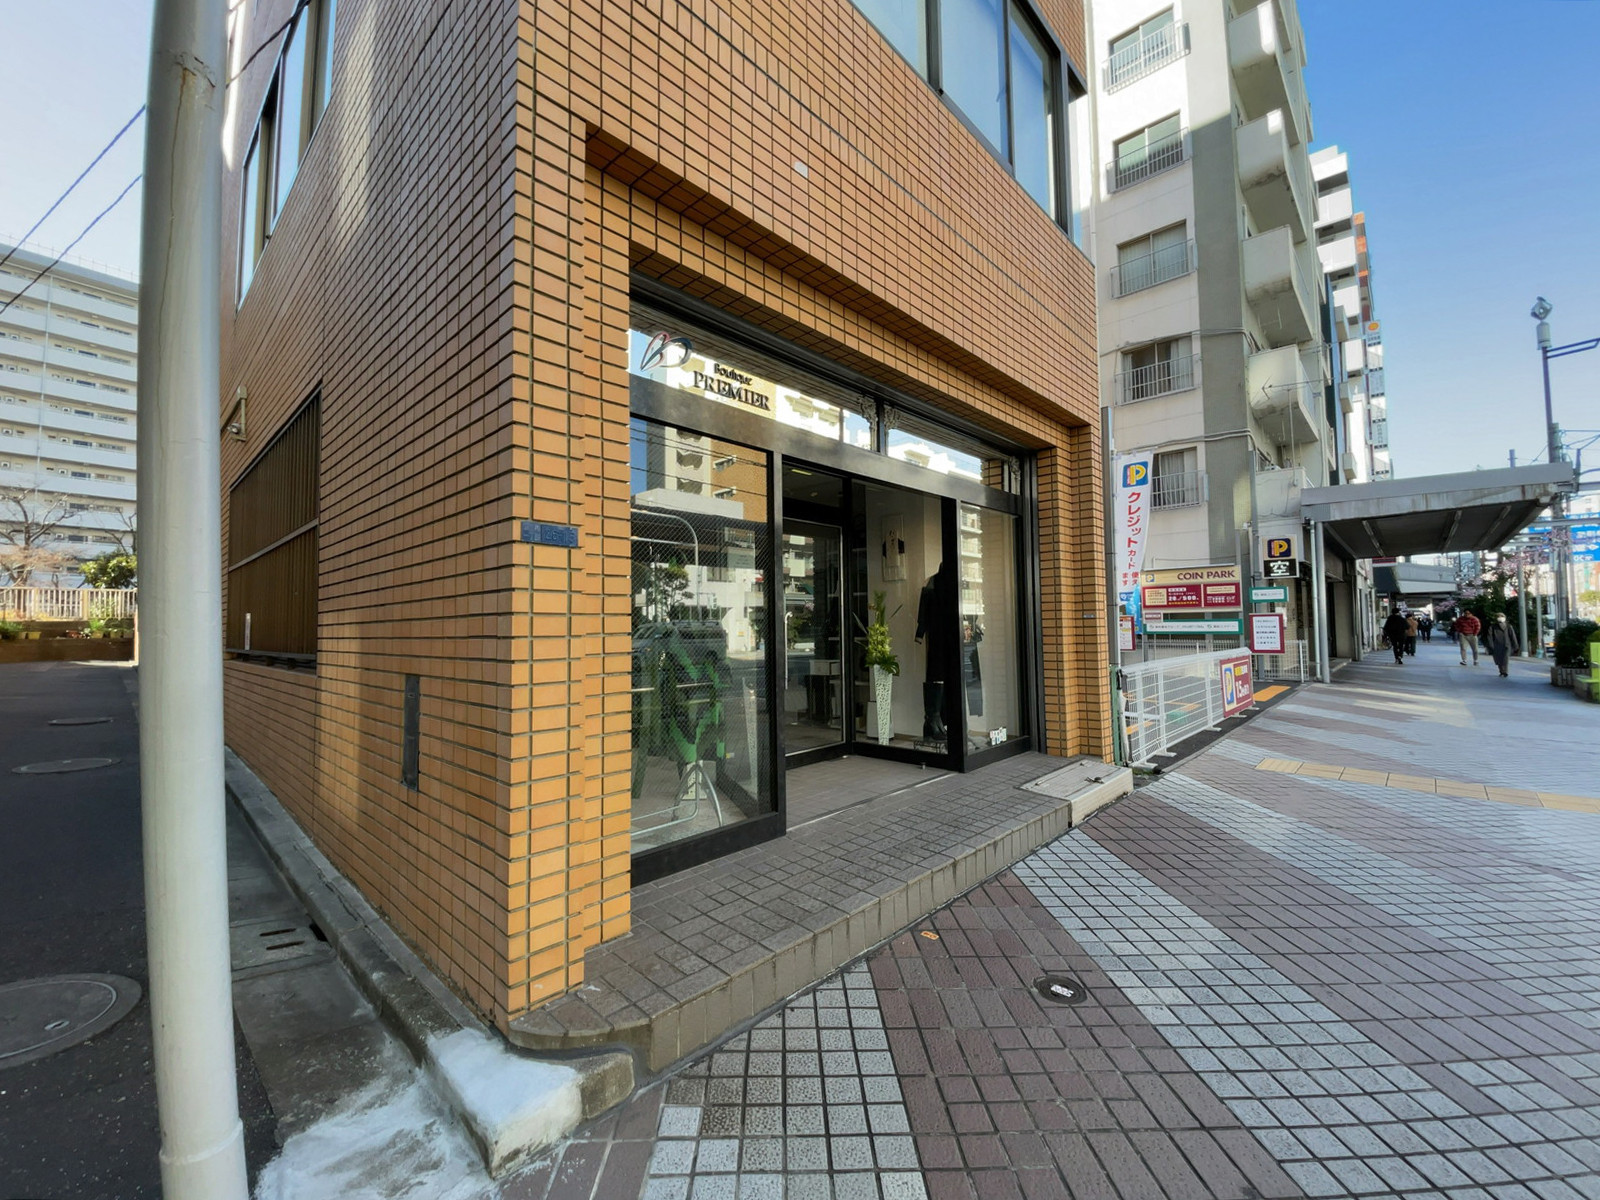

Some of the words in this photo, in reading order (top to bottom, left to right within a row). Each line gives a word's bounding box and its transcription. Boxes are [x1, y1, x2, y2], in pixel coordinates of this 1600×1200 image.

[693, 371, 770, 411] PREMIER
[1177, 571, 1204, 580] COIN
[1206, 570, 1235, 579] PARK
[1269, 561, 1290, 576] 空
